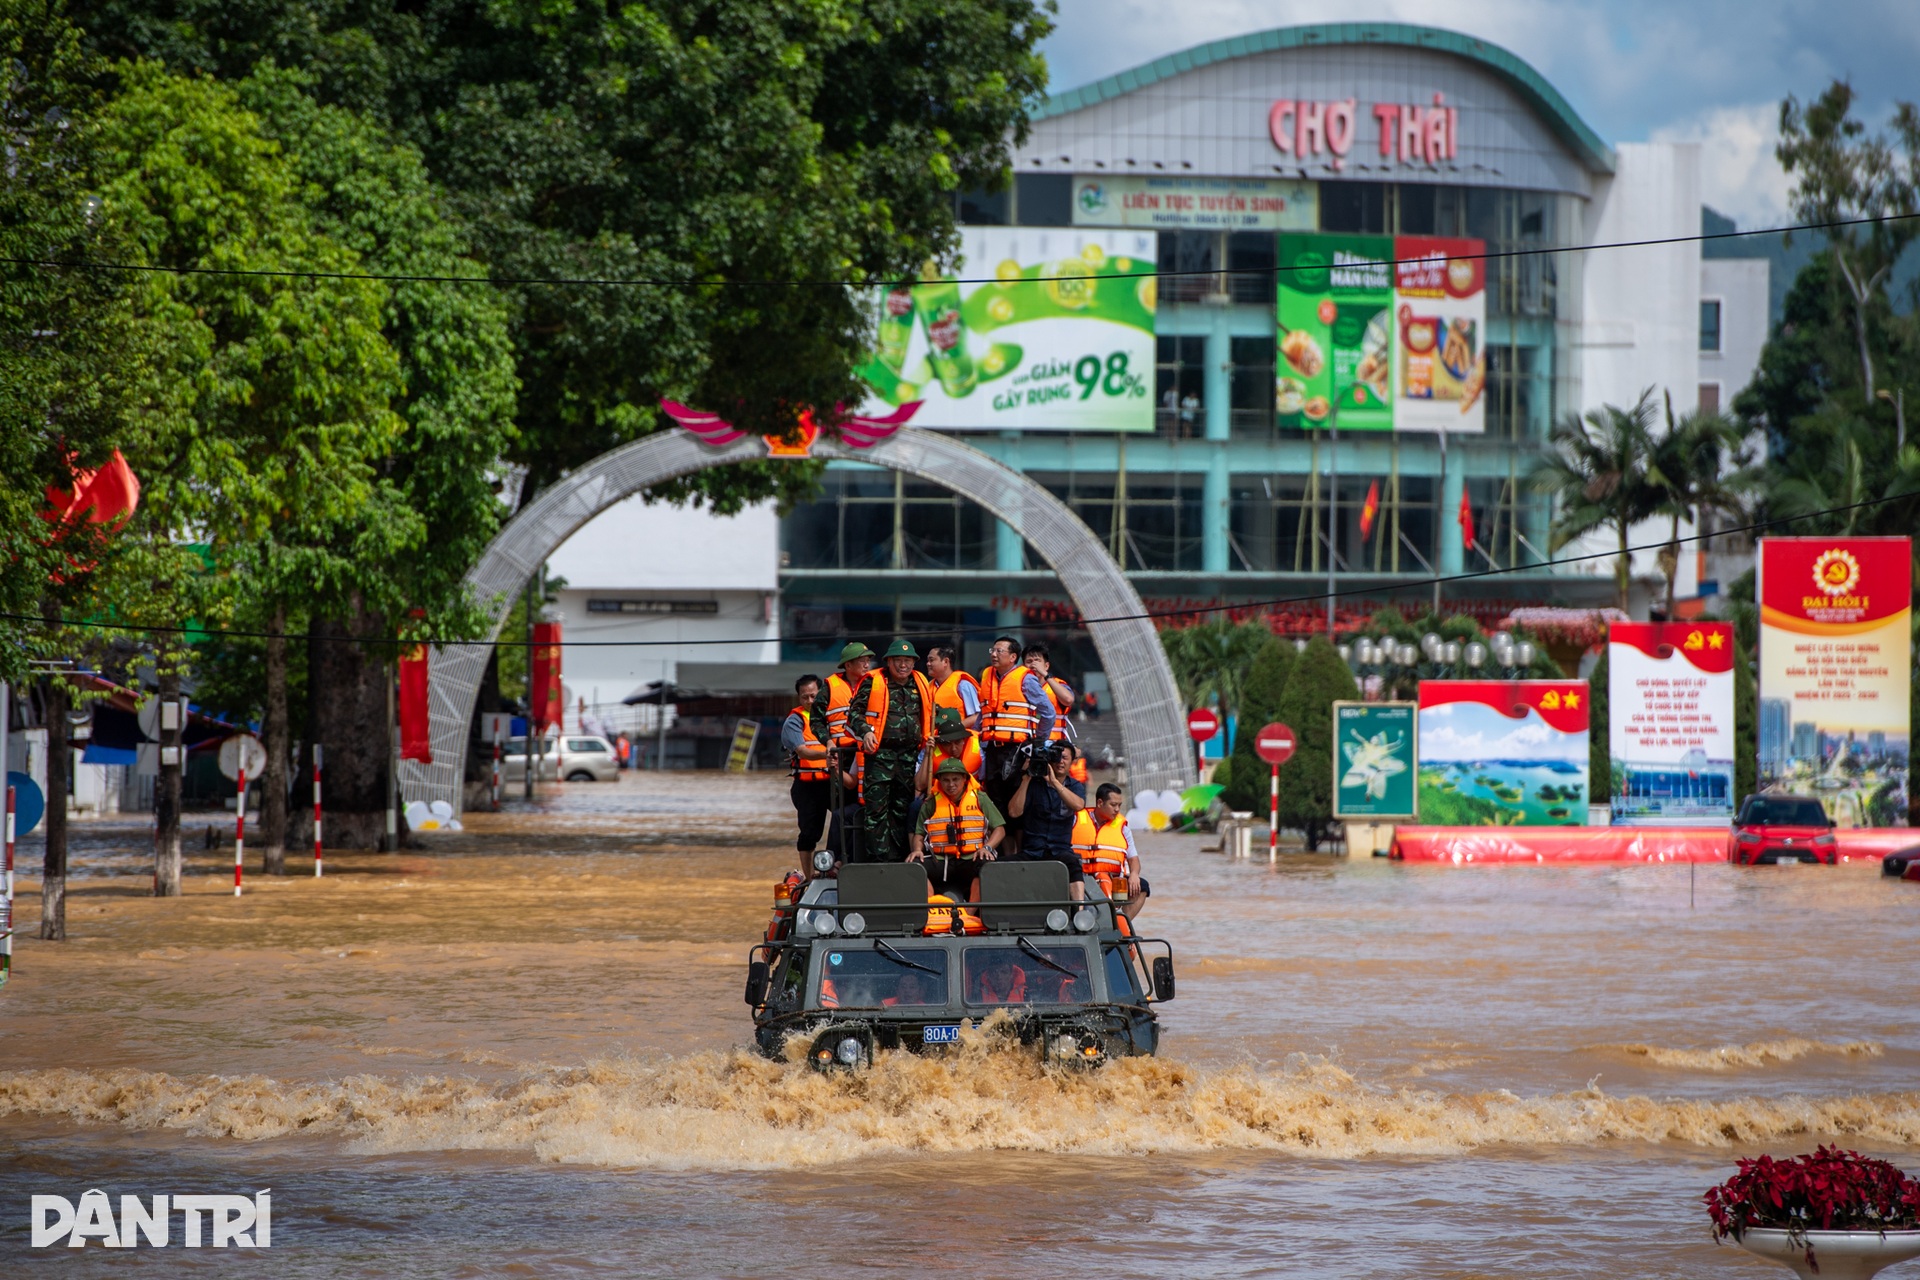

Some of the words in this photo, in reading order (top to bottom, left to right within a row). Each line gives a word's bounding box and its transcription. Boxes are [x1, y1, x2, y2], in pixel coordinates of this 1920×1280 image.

[1269, 98, 1355, 171] CHỢ
[1371, 92, 1458, 164] THÁI
[926, 1027, 960, 1041] 80A-0
